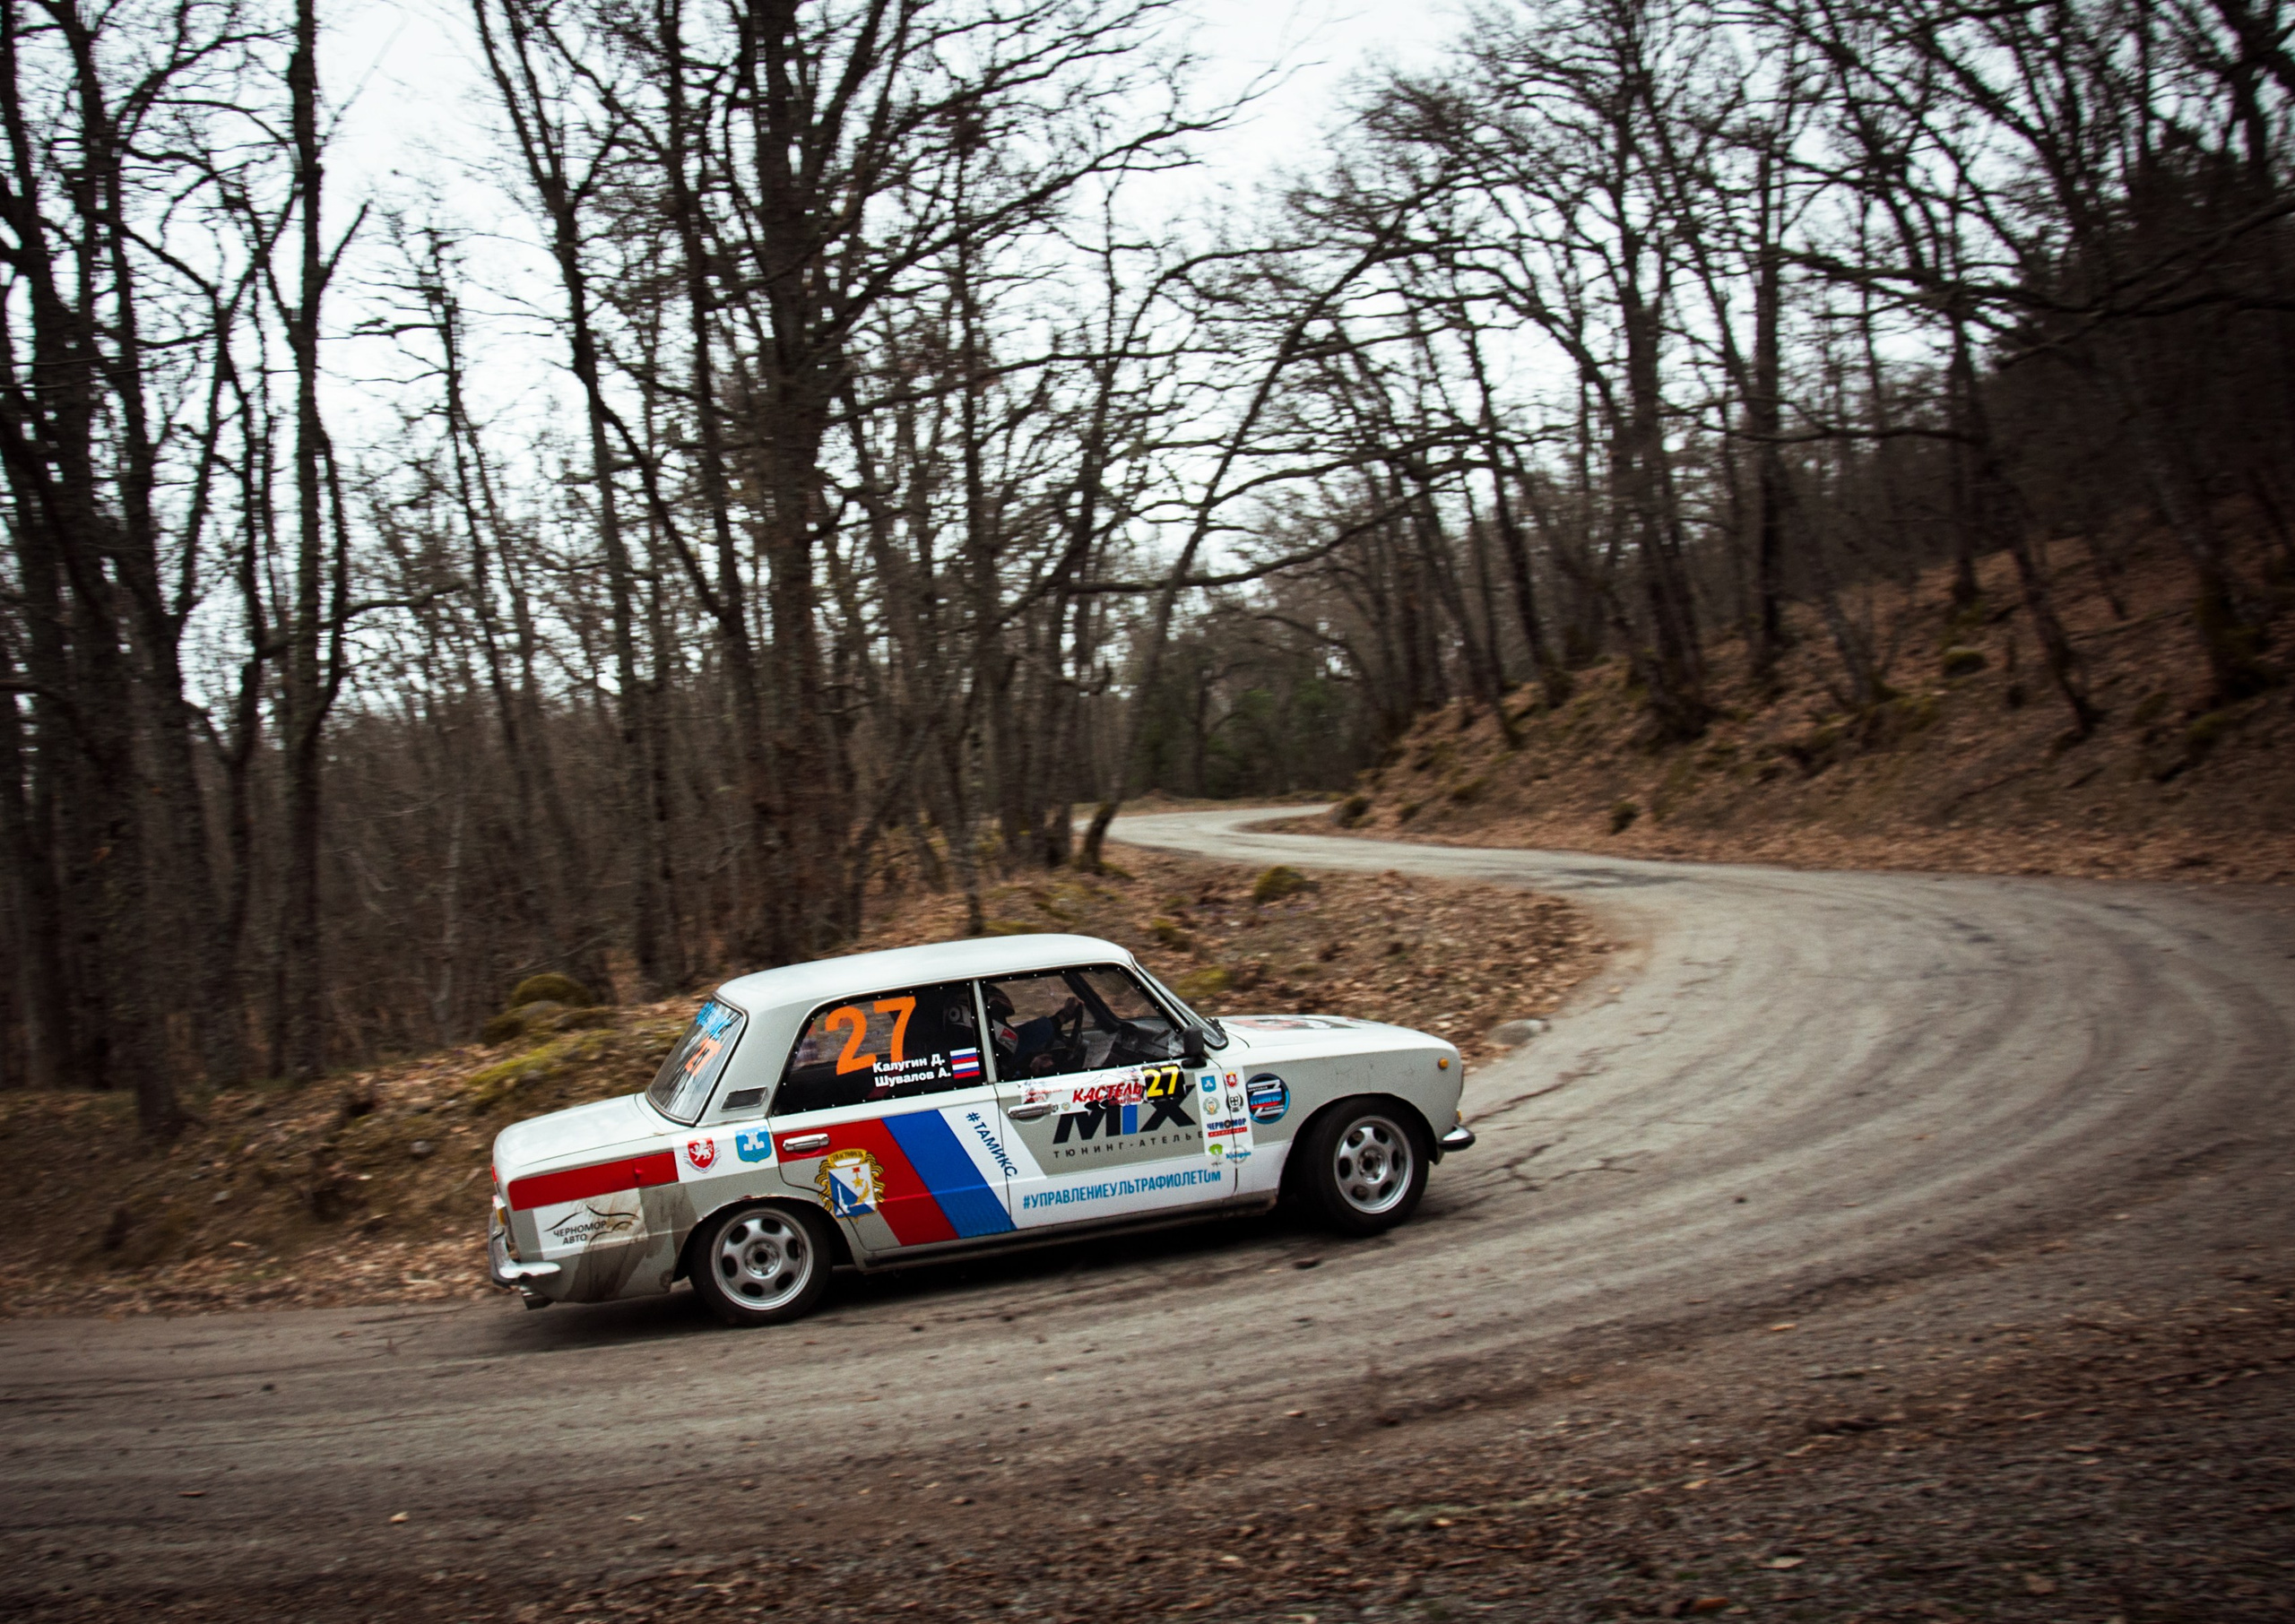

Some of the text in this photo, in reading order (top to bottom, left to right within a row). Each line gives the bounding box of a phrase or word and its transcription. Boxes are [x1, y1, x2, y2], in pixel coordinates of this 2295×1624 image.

[825, 996, 916, 1075] 27
[872, 1053, 945, 1073] Калугин Д.
[874, 1067, 951, 1087] Шувалов А.
[1143, 1066, 1179, 1097] 27
[1072, 1082, 1142, 1103] КАСТЕЛЬ
[966, 1111, 1018, 1177] #ТАМИКС
[1053, 1130, 1203, 1159] ТЮНИНГ-АТЕЛЬЕ
[553, 1220, 607, 1238] ЧЕРНОМОР
[562, 1233, 587, 1246] АВТО
